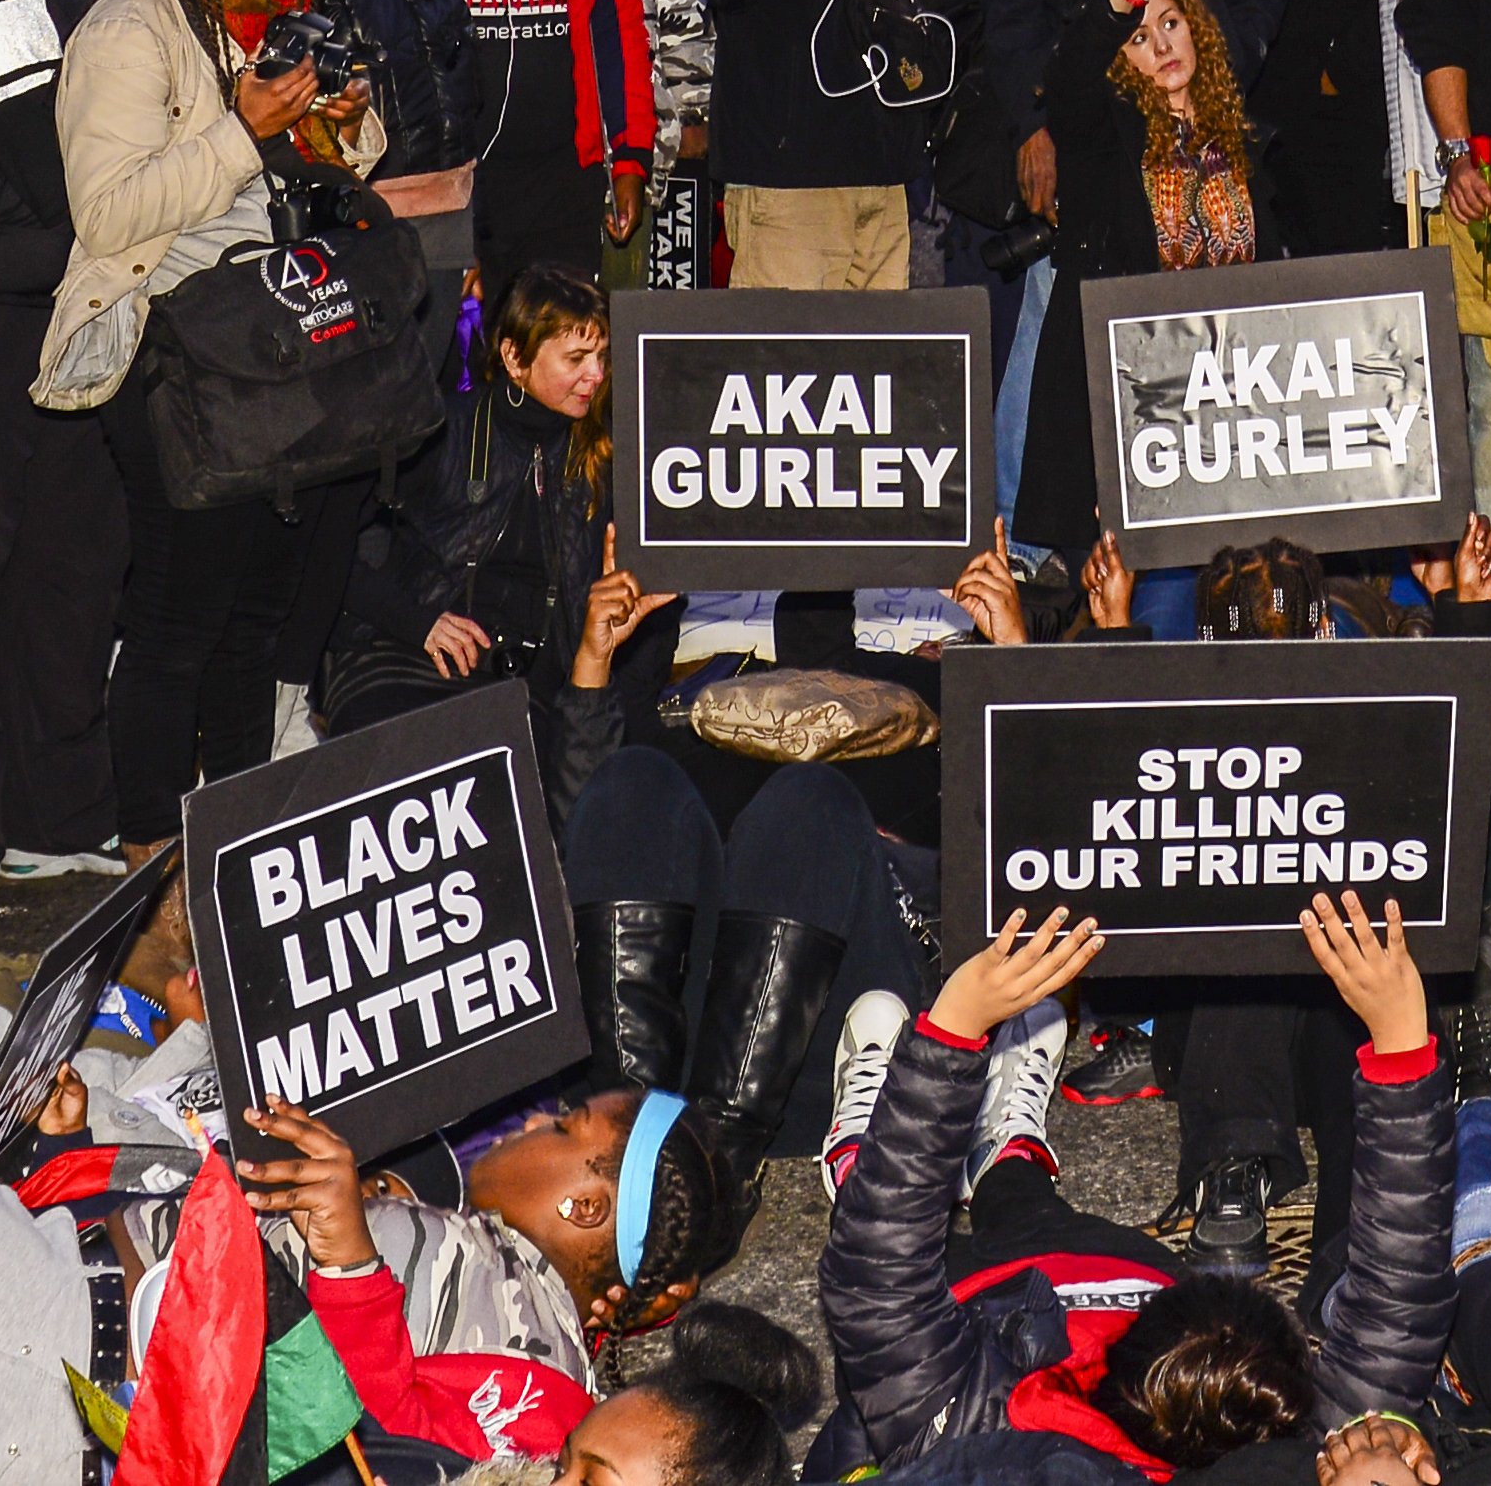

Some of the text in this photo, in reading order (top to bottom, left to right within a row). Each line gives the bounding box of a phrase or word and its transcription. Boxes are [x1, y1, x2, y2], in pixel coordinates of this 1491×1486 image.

[656, 210, 673, 288] TAK
[675, 190, 692, 249] WE
[307, 279, 348, 303] YEARS
[310, 319, 358, 344] Canon
[709, 373, 893, 435] AKAI
[1181, 340, 1358, 412] AKAI
[650, 446, 958, 509] GURLEY
[1129, 403, 1422, 490] GURLEY
[1137, 746, 1302, 792] STOP
[1092, 792, 1346, 842] KILLING
[249, 777, 489, 929] BLACK
[1005, 840, 1428, 892] OUR FRIENDS
[282, 870, 484, 1010] LIVES
[256, 939, 542, 1105] MATTER
